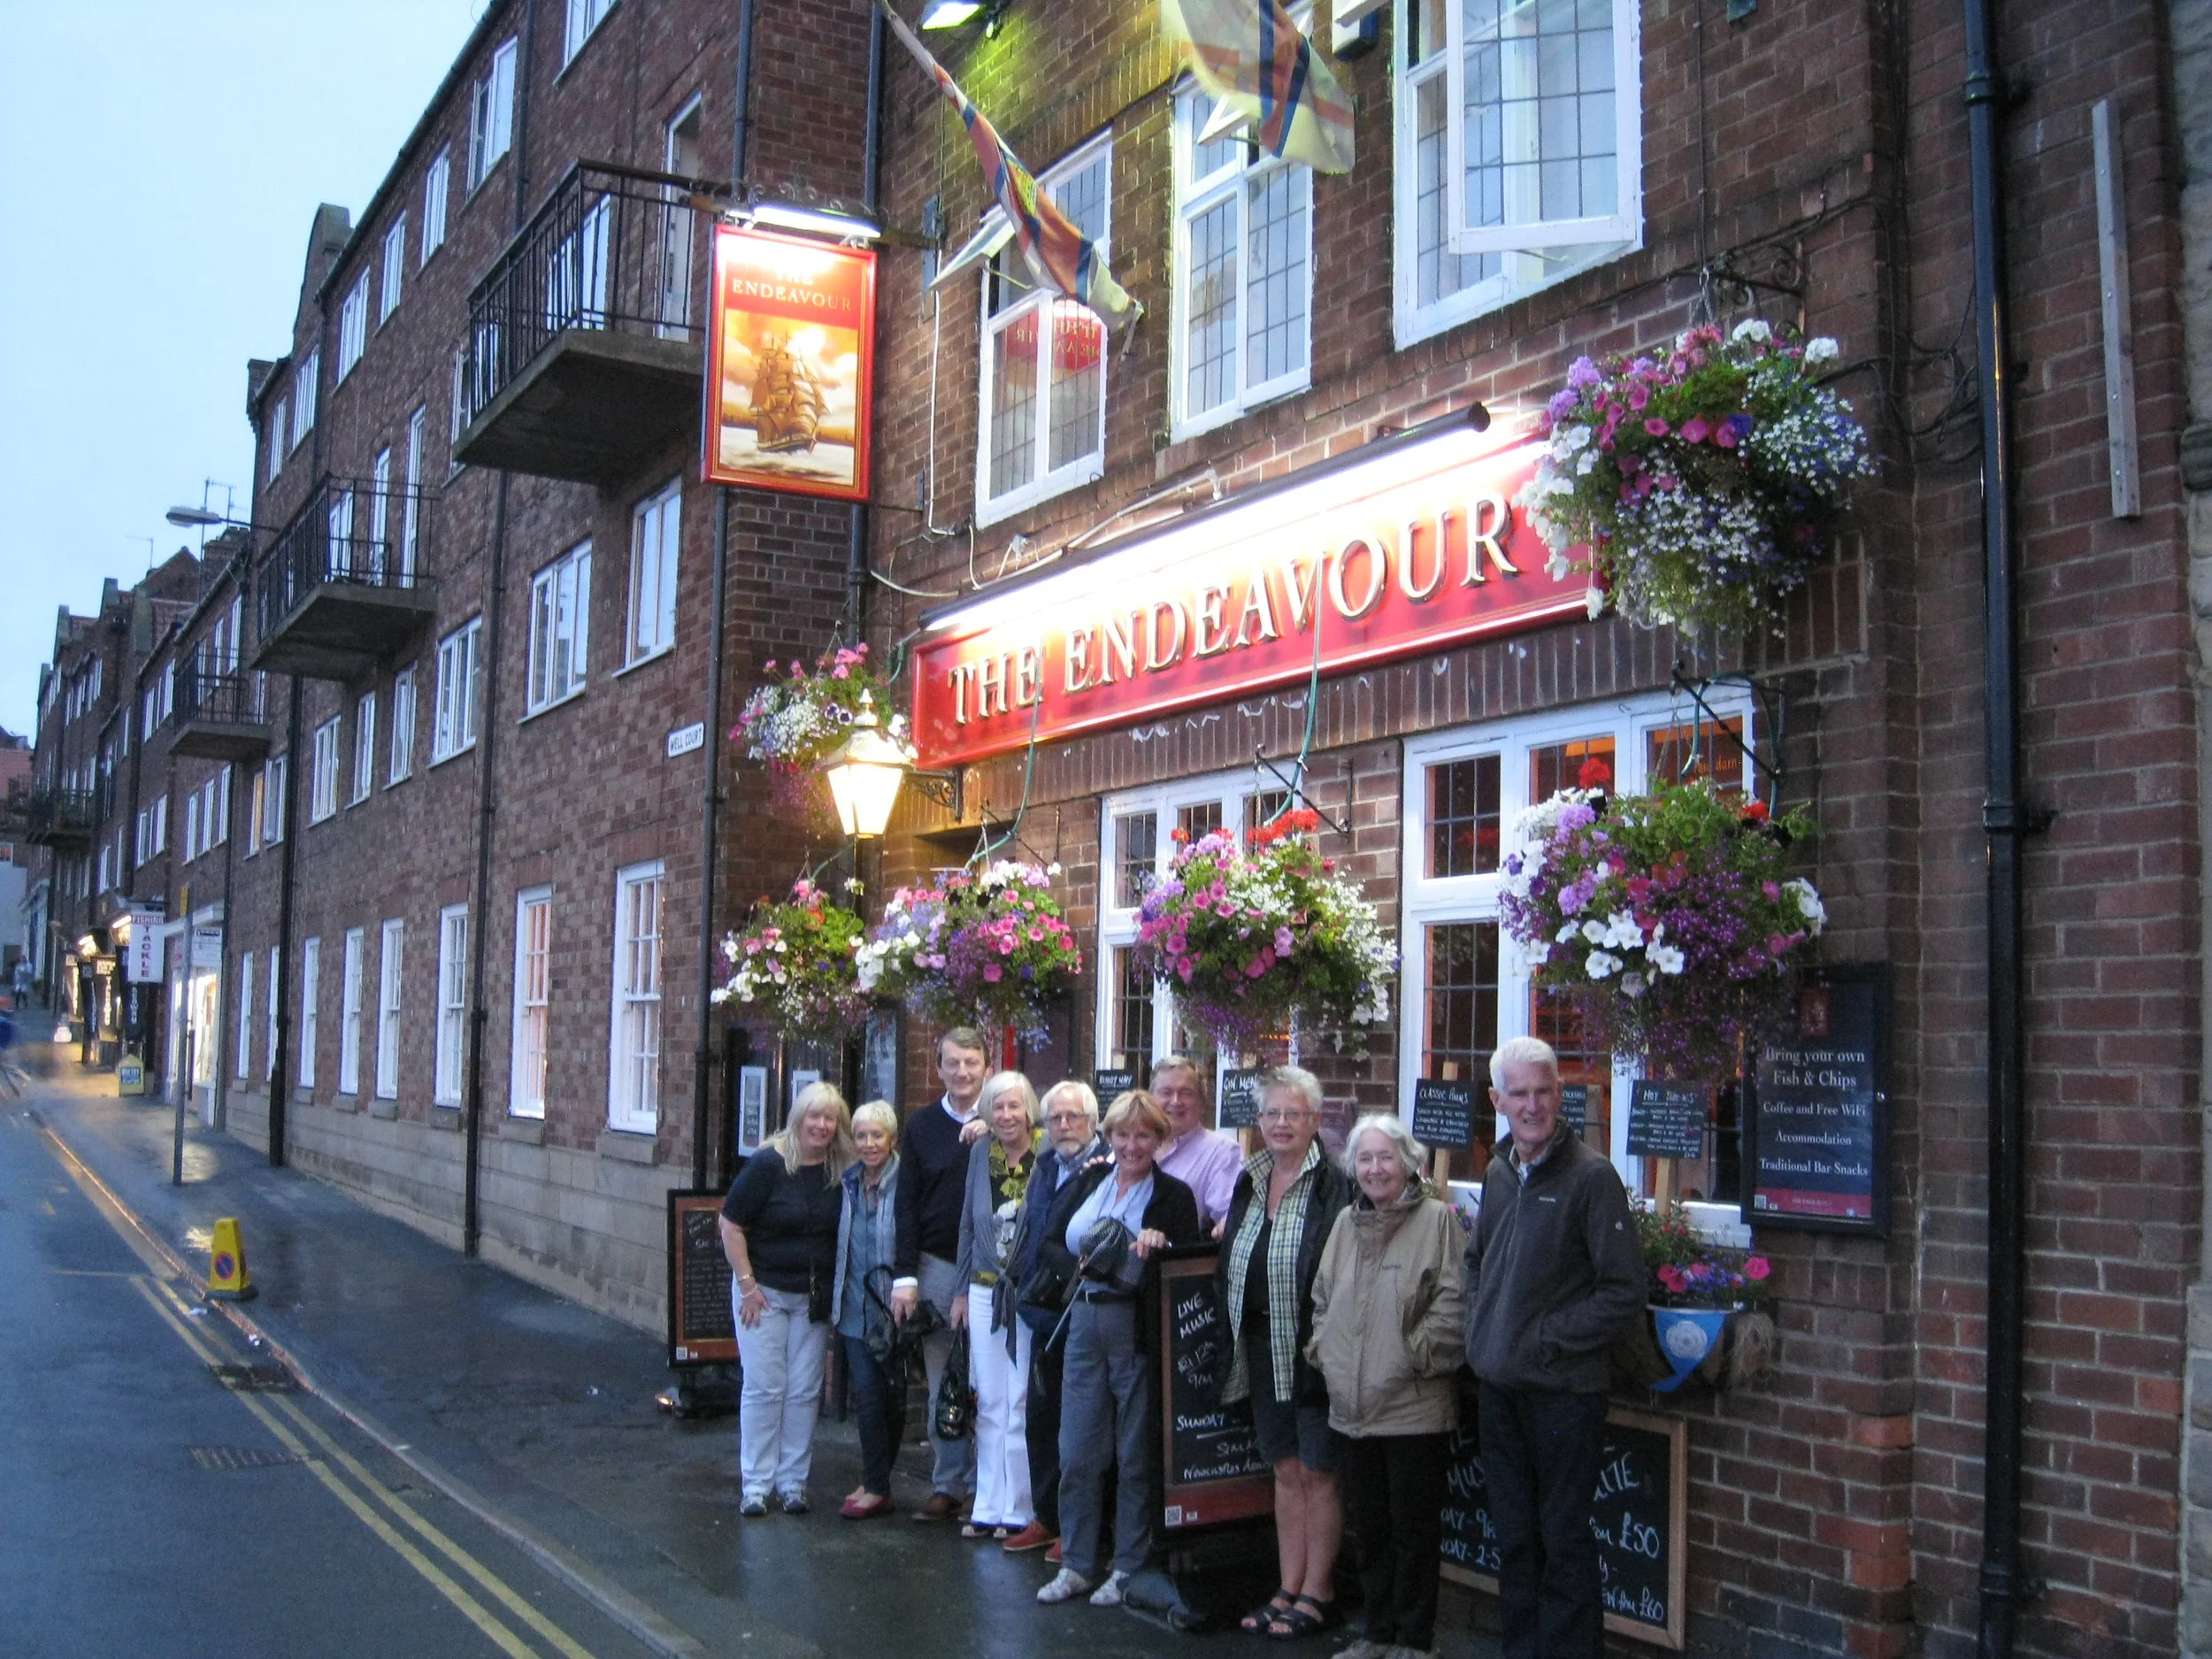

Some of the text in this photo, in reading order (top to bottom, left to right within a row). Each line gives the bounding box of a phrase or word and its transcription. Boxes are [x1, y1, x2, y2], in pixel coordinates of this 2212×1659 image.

[732, 278, 853, 312] ENDEAVOUR
[947, 494, 1520, 726] THE ENDEAVOUR
[132, 915, 164, 926] FISHING
[142, 926, 151, 978] TACKLE
[1766, 1046, 1865, 1067] Bring your own
[1239, 1072, 1259, 1090] MEN
[1773, 1070, 1857, 1091] Fish & Chips
[1763, 1101, 1794, 1114] Coffee
[1795, 1102, 1814, 1114] and
[1816, 1102, 1839, 1115] Free
[1776, 1130, 1852, 1146] Accommodation
[1760, 1156, 1869, 1176] Traditional Bar Snacks
[1178, 1292, 1203, 1320] LIVE
[1179, 1307, 1217, 1340] MUSIC
[1446, 1456, 1486, 1499] MUS
[1619, 1511, 1661, 1560] £50
